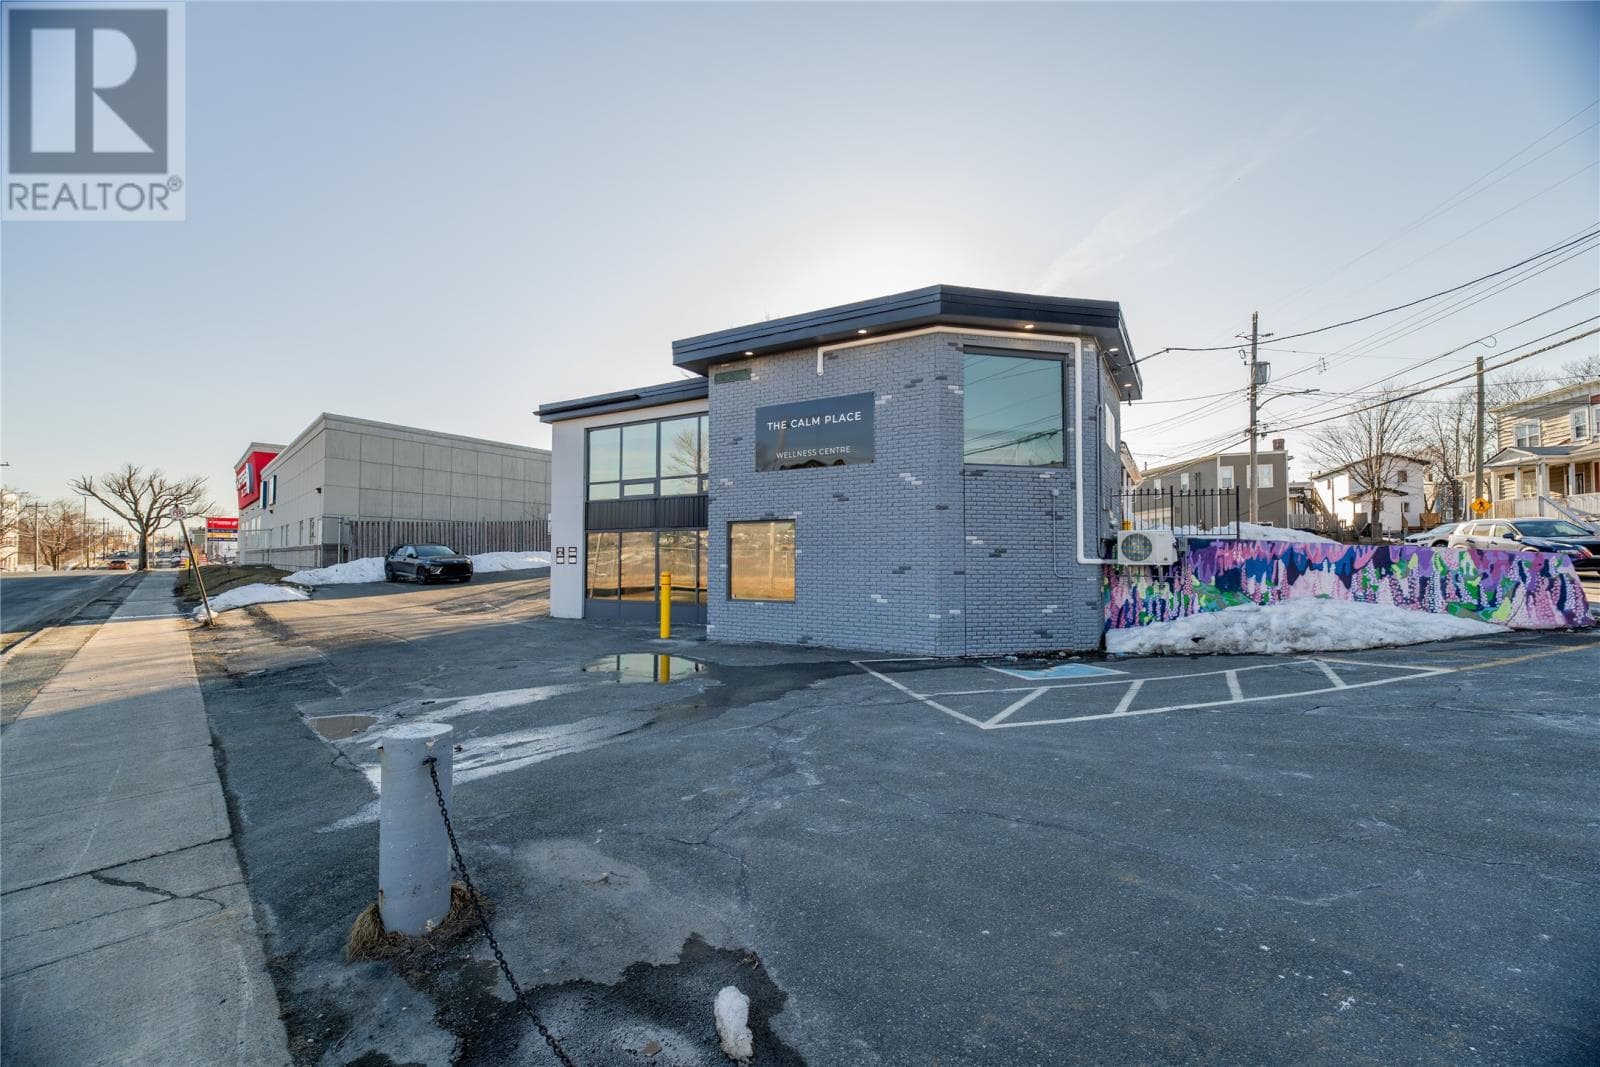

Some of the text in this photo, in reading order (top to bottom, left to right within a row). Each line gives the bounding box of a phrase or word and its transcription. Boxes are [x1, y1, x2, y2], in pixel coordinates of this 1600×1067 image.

[767, 411, 862, 431] THE CALM PLACE
[776, 446, 851, 460] WELLNESS CENTRE
